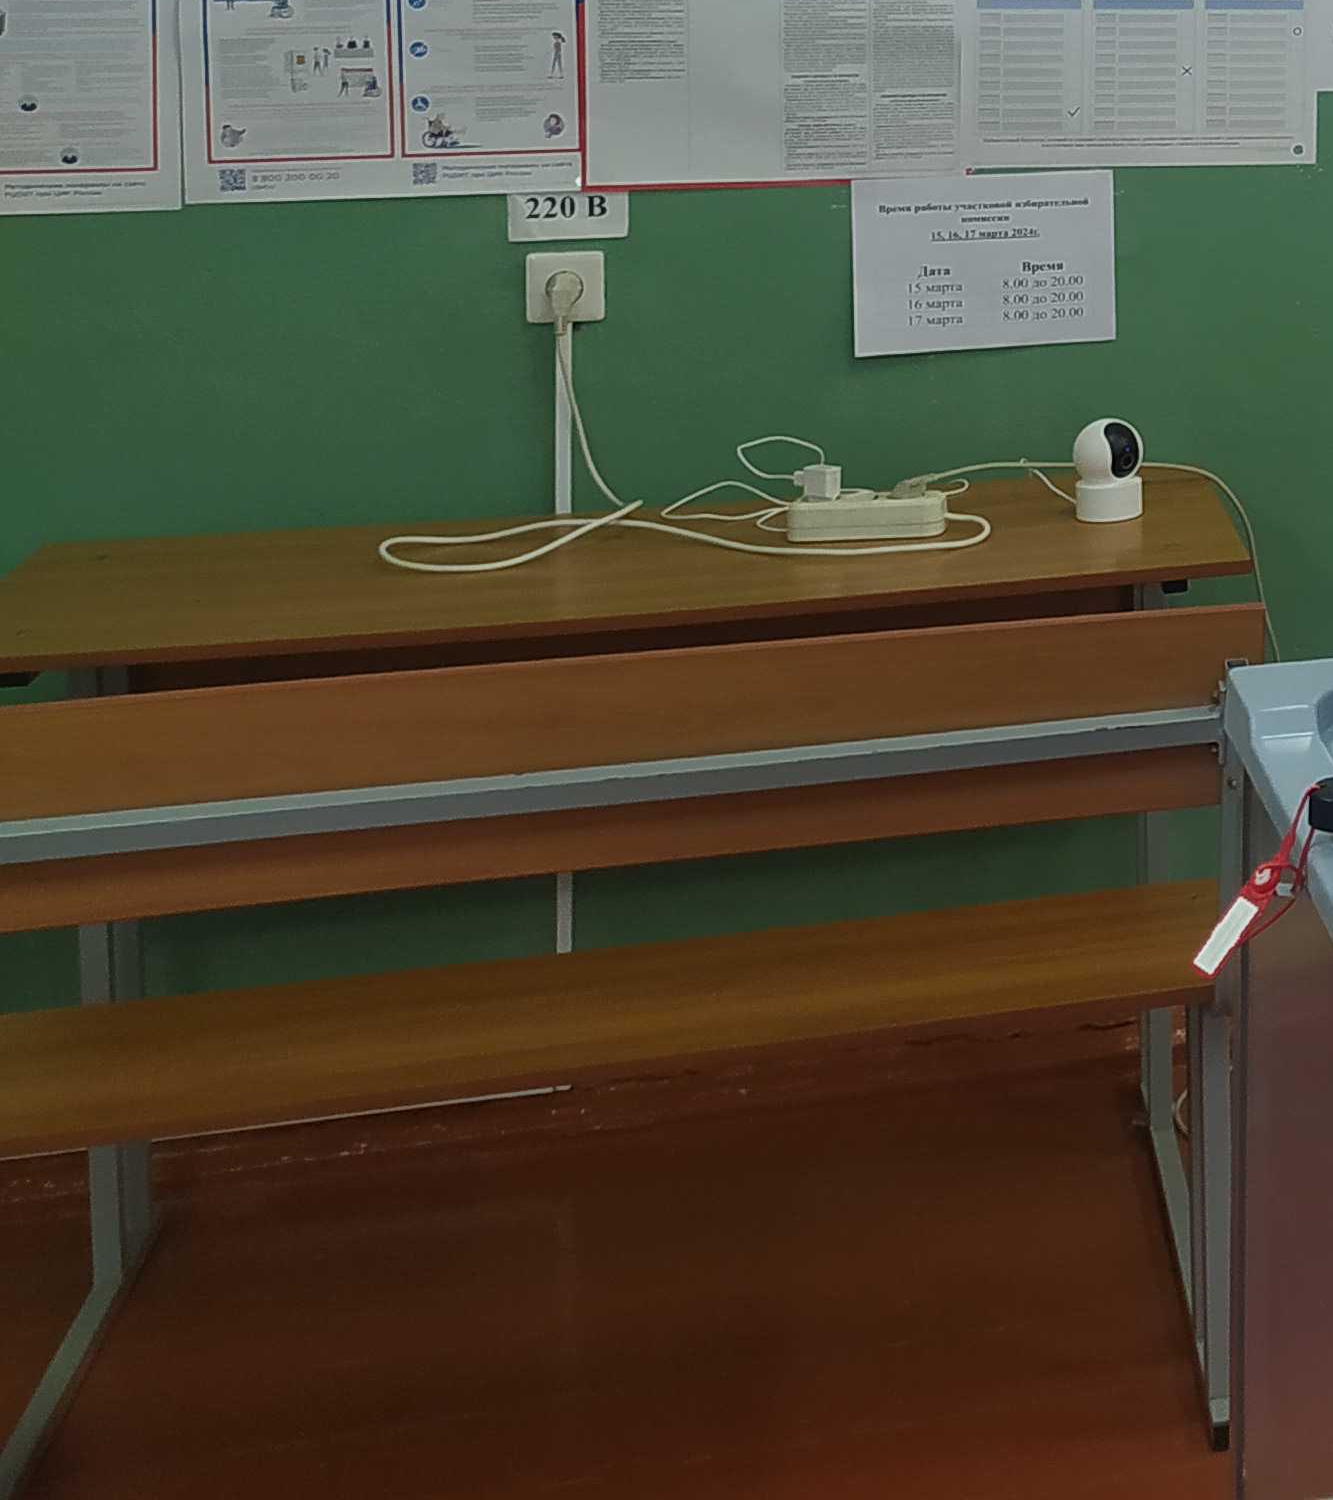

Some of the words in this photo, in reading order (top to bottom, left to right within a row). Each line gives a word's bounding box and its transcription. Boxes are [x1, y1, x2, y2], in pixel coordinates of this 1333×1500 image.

[526, 195, 576, 220] 220
[588, 194, 608, 218] В
[914, 202, 953, 215] работы
[954, 200, 1013, 214] участковой
[1015, 197, 1090, 210] избирательной
[917, 264, 952, 279] Дата
[1021, 260, 1065, 276] Время
[908, 283, 922, 294] 15
[926, 283, 963, 296] марта
[1002, 278, 1029, 290] 8.00
[1031, 279, 1048, 290] до
[1050, 275, 1084, 288] 20.00
[908, 298, 923, 310] 16
[926, 299, 964, 312] марта
[1002, 293, 1029, 306] 8.00
[1031, 295, 1048, 306] до
[1050, 291, 1084, 304] 20.00
[908, 315, 922, 327] 17
[926, 315, 964, 329] марта
[1002, 309, 1029, 322] 8.00
[1031, 311, 1048, 322] до
[1051, 307, 1084, 319] 20.00
